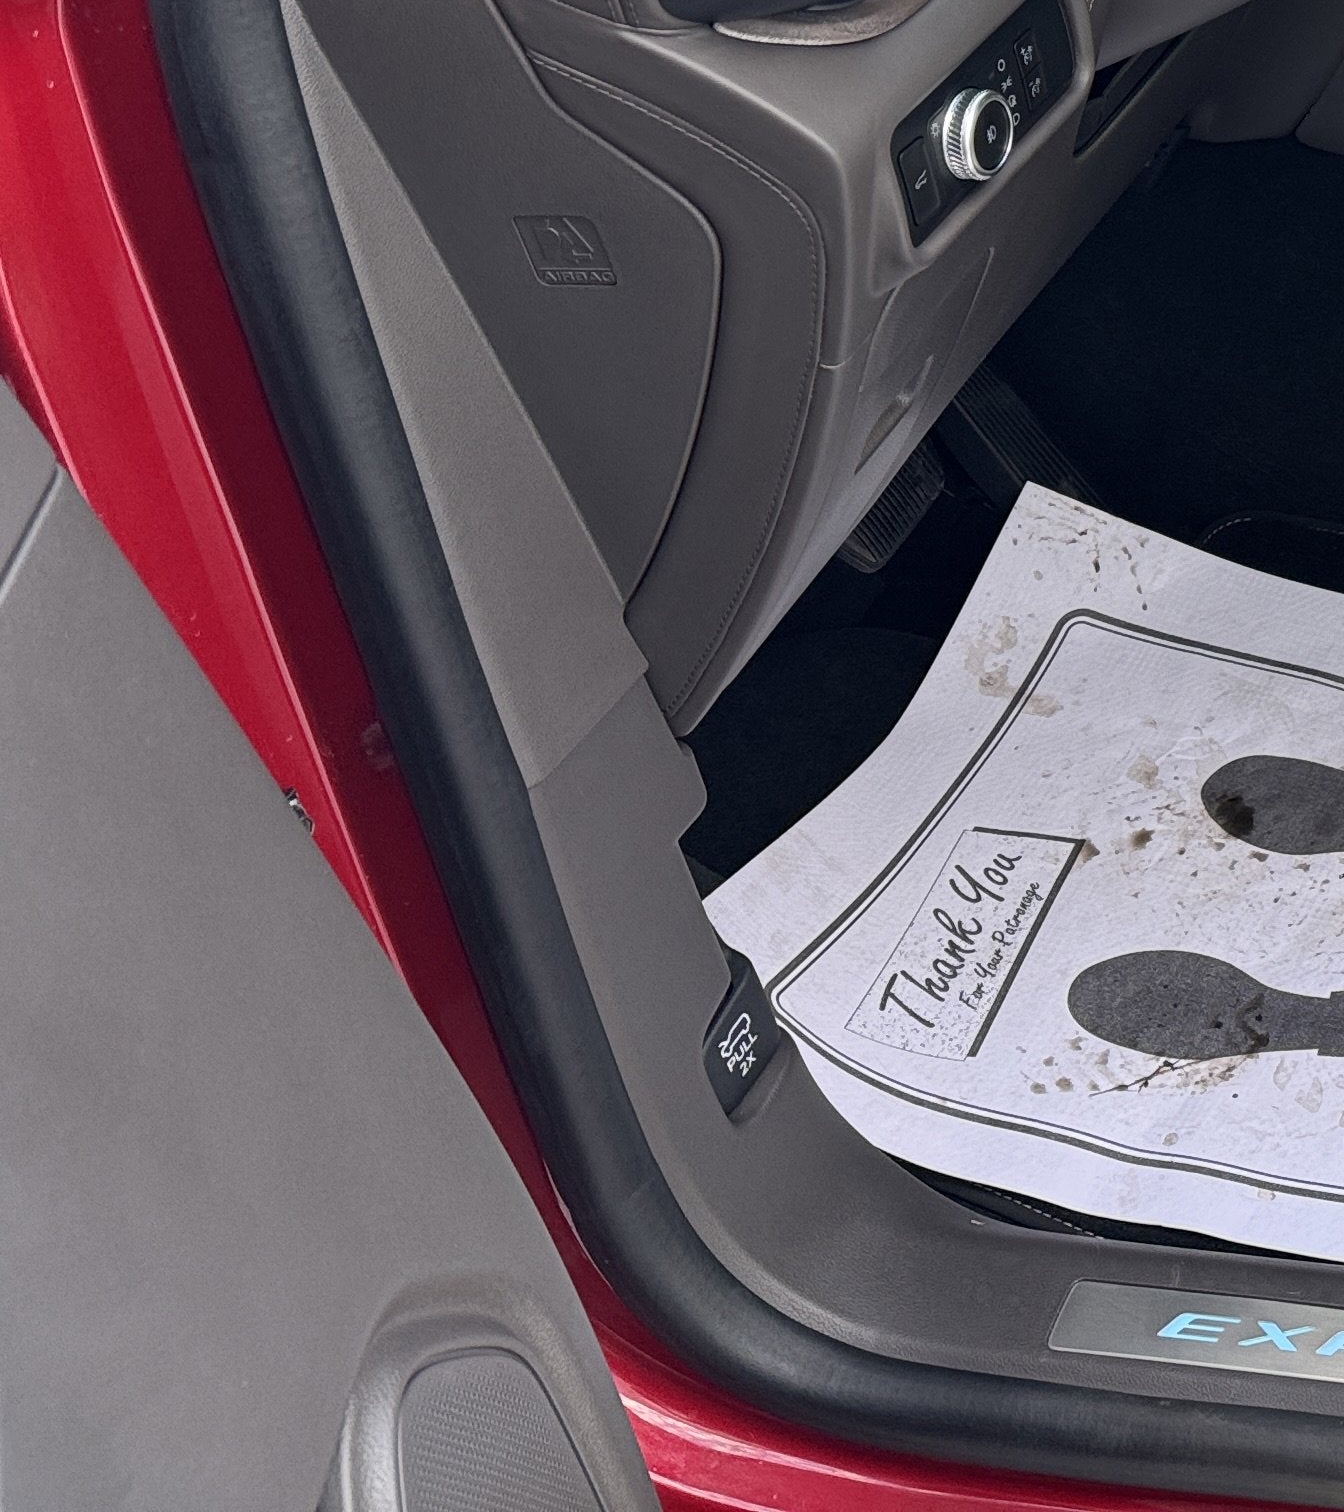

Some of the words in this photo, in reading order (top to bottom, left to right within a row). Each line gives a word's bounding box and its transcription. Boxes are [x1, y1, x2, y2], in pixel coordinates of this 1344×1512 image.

[879, 907, 983, 1029] Thank
[949, 853, 1023, 904] You
[958, 983, 985, 1010] For
[974, 948, 1004, 980] Your
[992, 881, 1045, 948] Patronage
[726, 1033, 758, 1073] PULL
[740, 1051, 757, 1077] 2X
